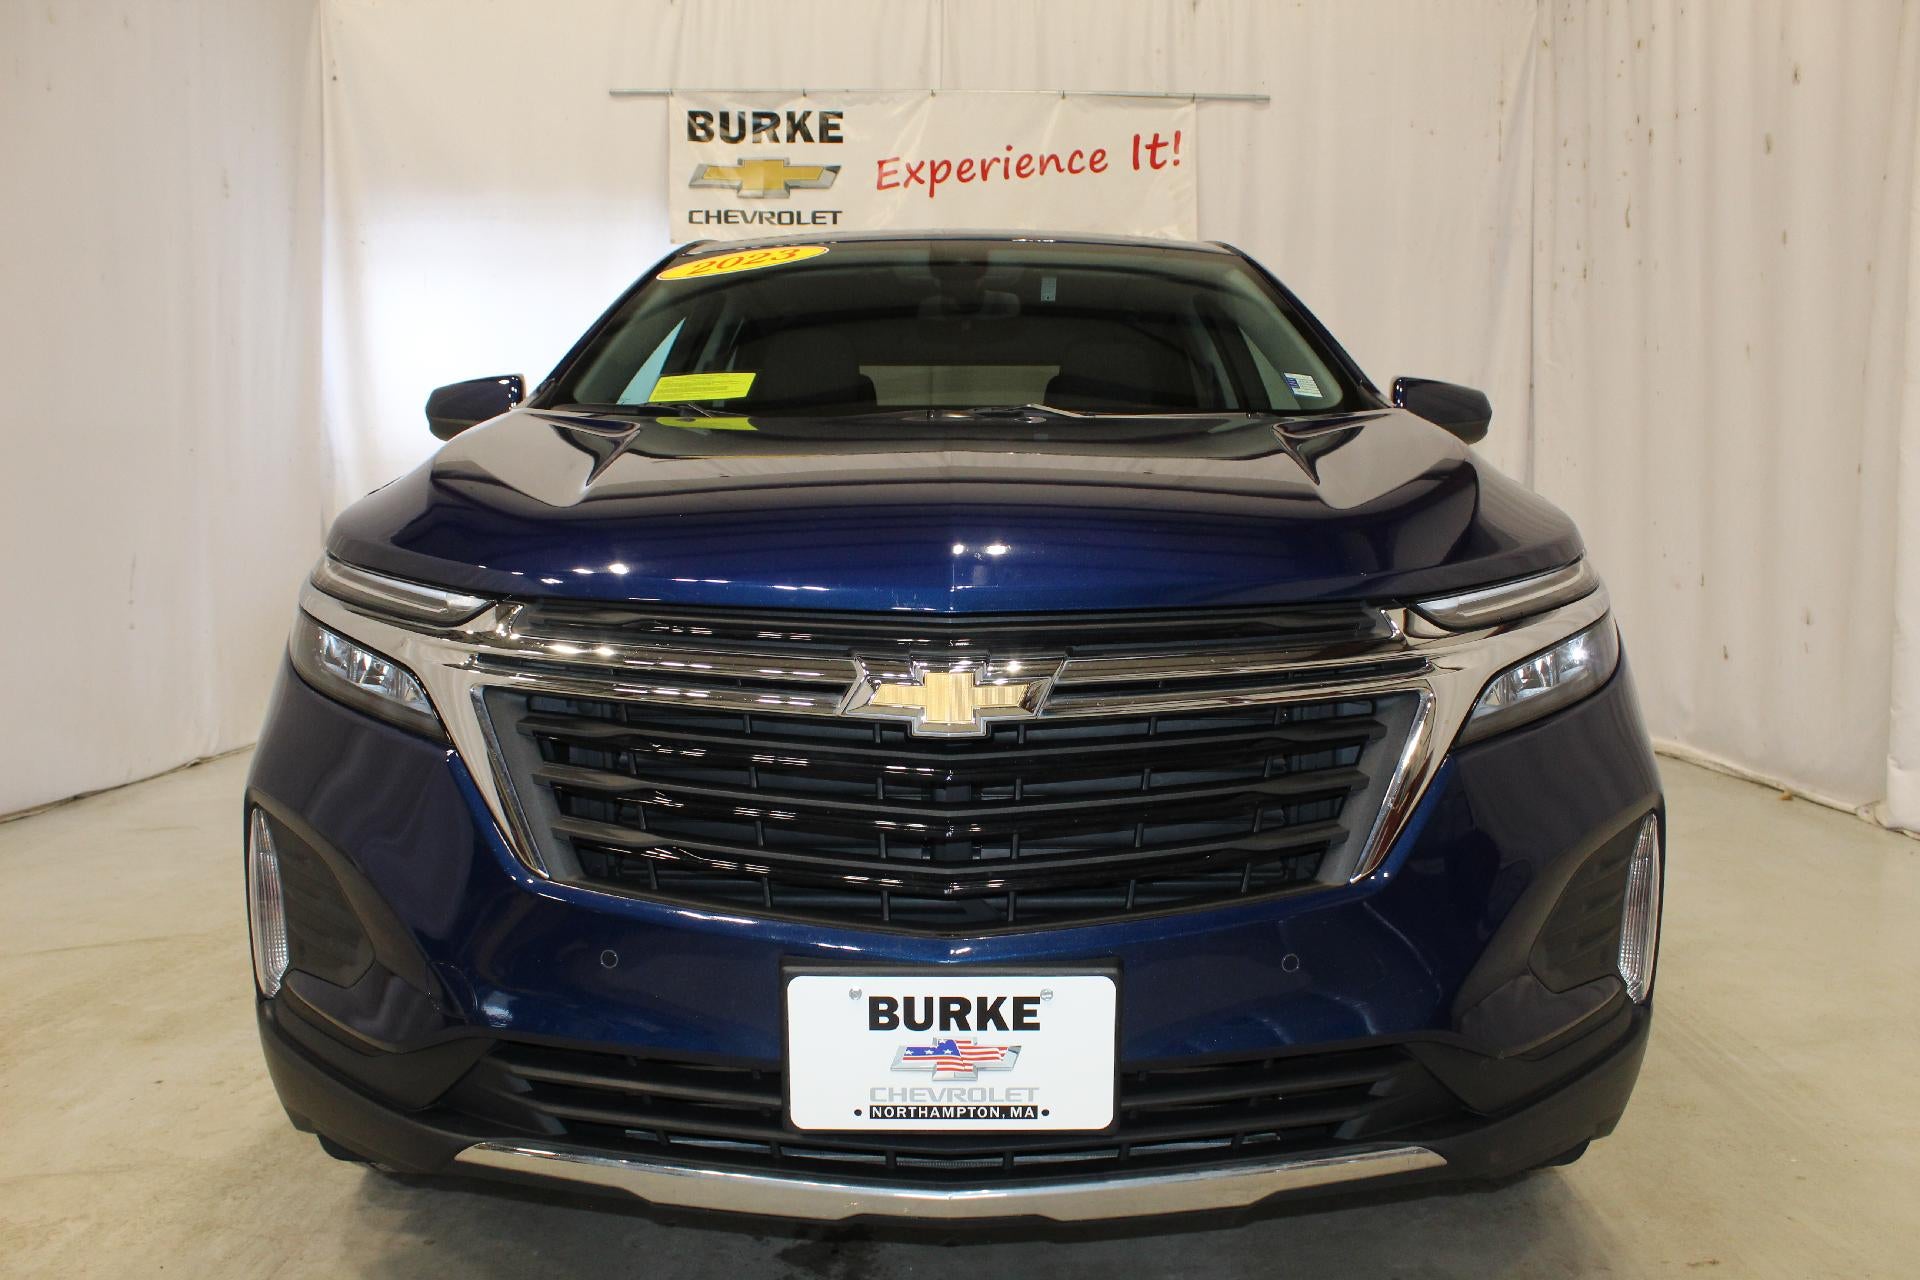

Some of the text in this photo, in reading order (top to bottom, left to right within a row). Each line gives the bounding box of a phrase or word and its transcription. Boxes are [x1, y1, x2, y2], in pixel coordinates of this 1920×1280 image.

[687, 110, 844, 144] BURKE
[876, 131, 1182, 198] Experience It!
[688, 210, 843, 226] CHEVROLET
[687, 248, 801, 276] 2023
[868, 996, 1041, 1031] BURKE
[869, 1087, 1040, 1103] CHEVROLET
[871, 1106, 1035, 1119] NORTHAMPTON, MA
